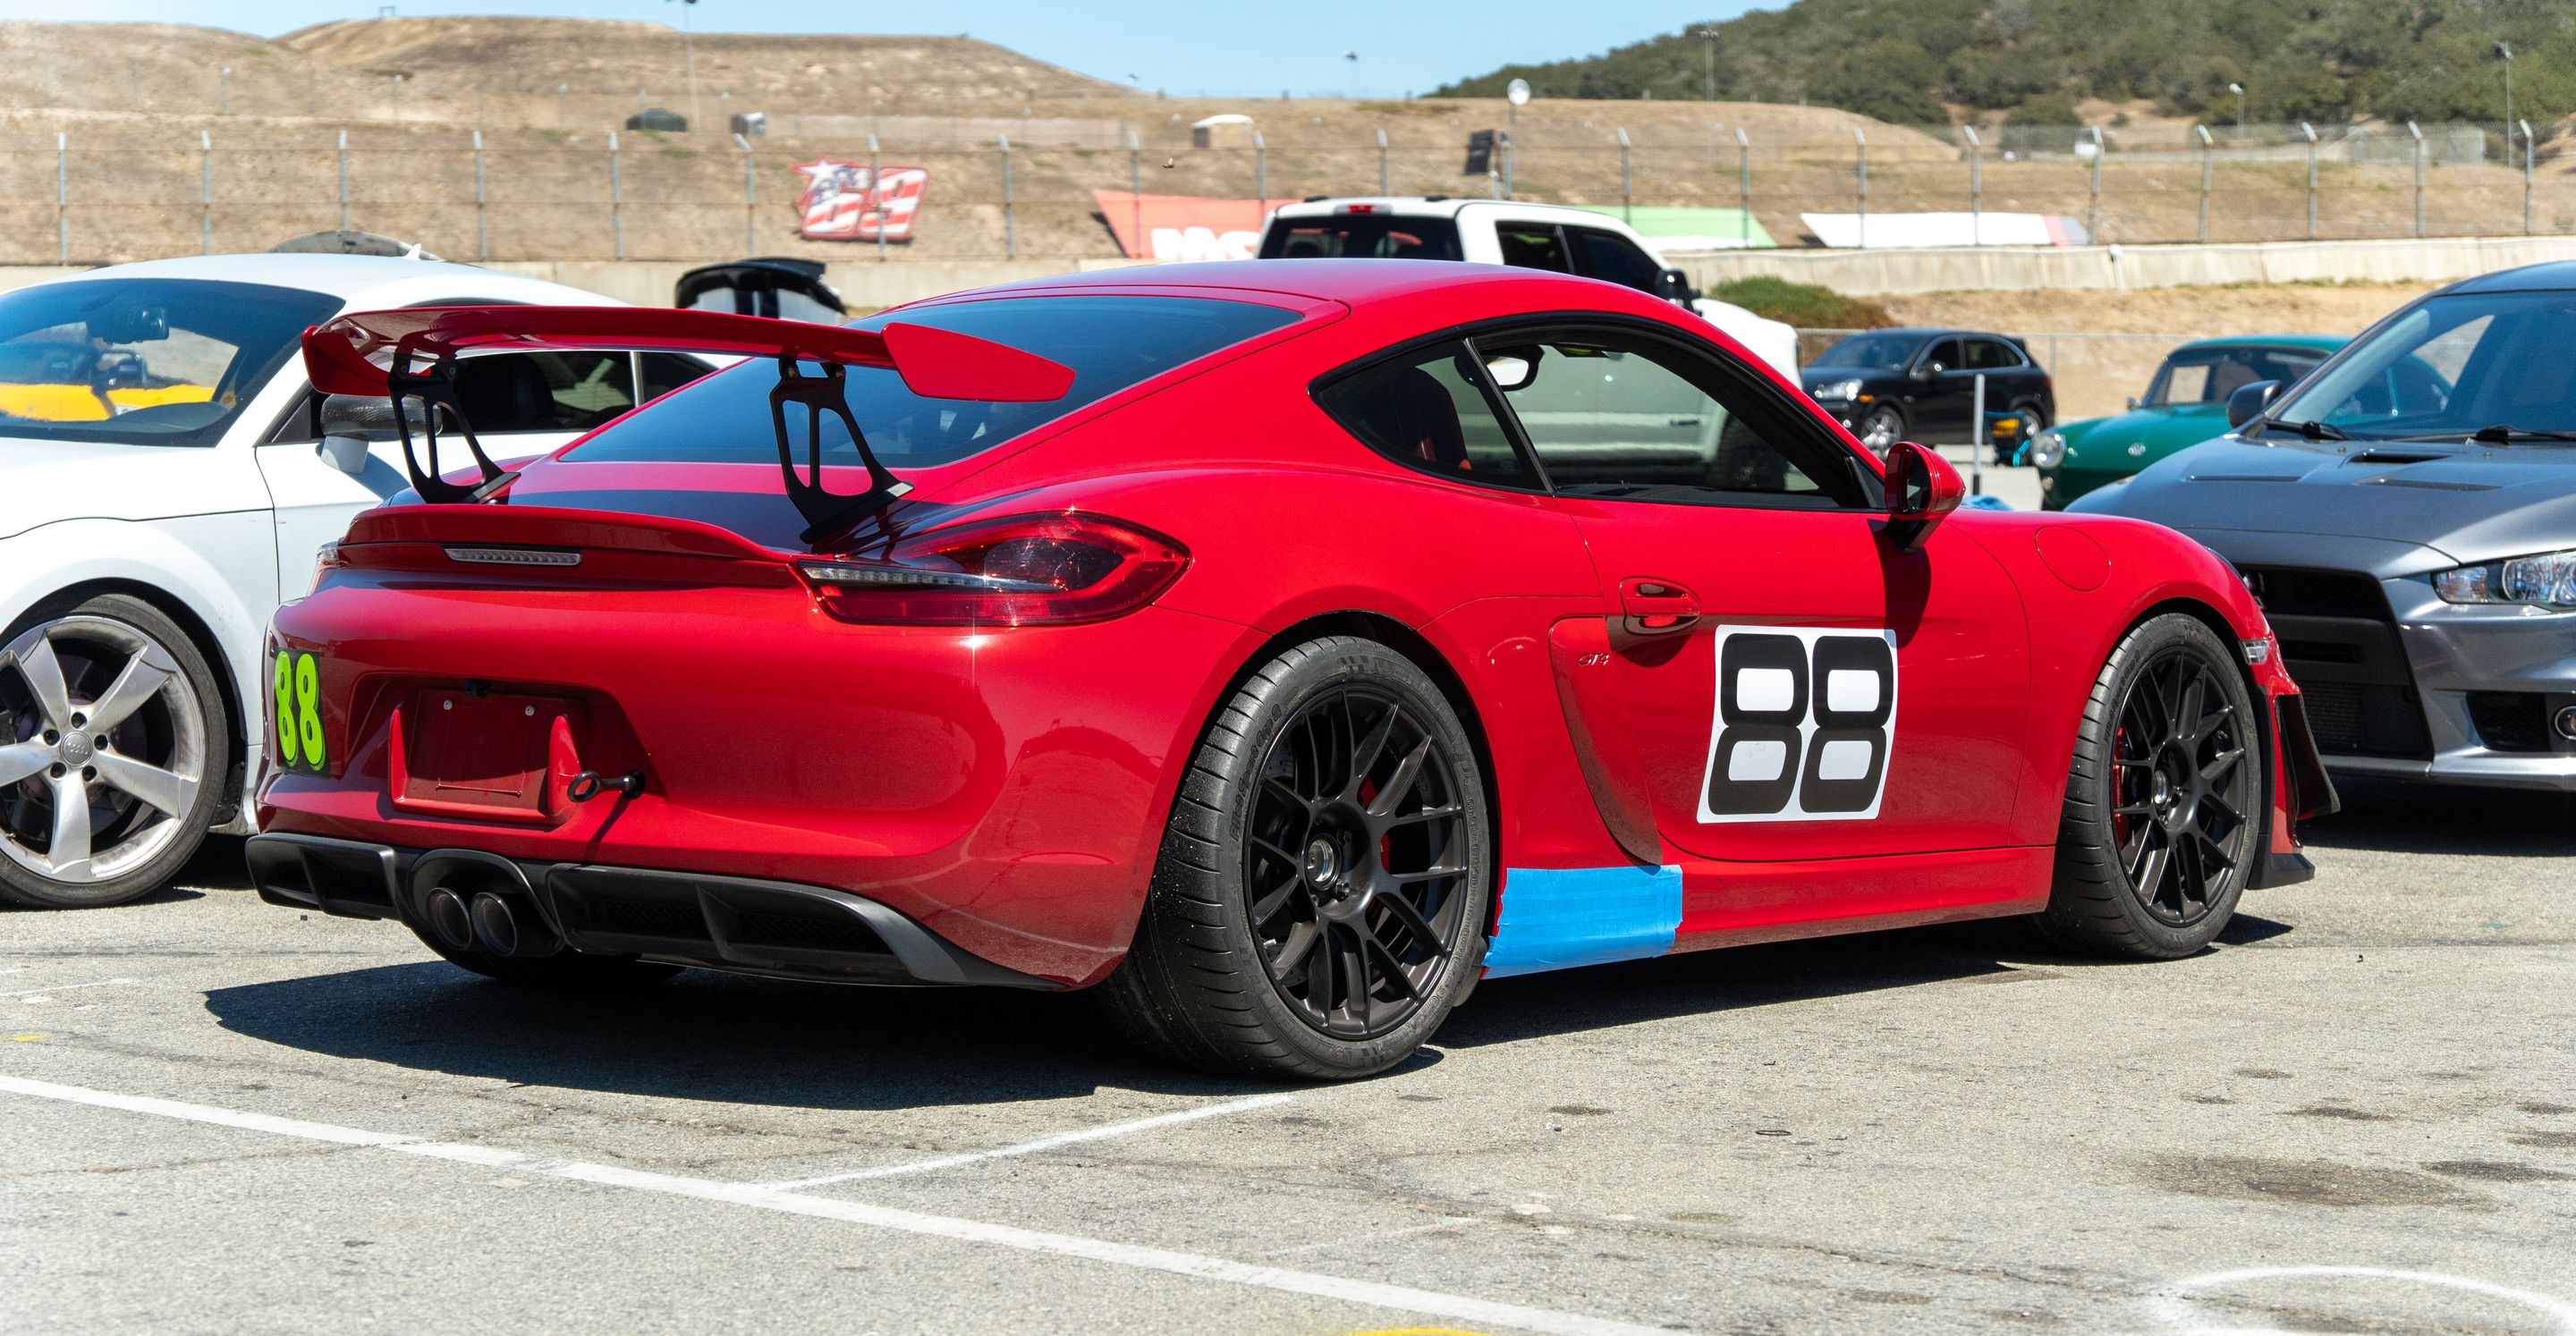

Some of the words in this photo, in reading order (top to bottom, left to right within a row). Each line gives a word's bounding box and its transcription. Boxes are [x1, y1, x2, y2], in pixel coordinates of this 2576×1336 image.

[801, 162, 928, 238] 69
[275, 650, 325, 771] 88
[1579, 653, 1609, 665] GT4
[1229, 793, 1244, 841] Pilot
[1238, 745, 1260, 797] Sport
[1256, 718, 1274, 748] Cup
[1271, 703, 1282, 722] 2
[1707, 632, 1894, 815] 88
